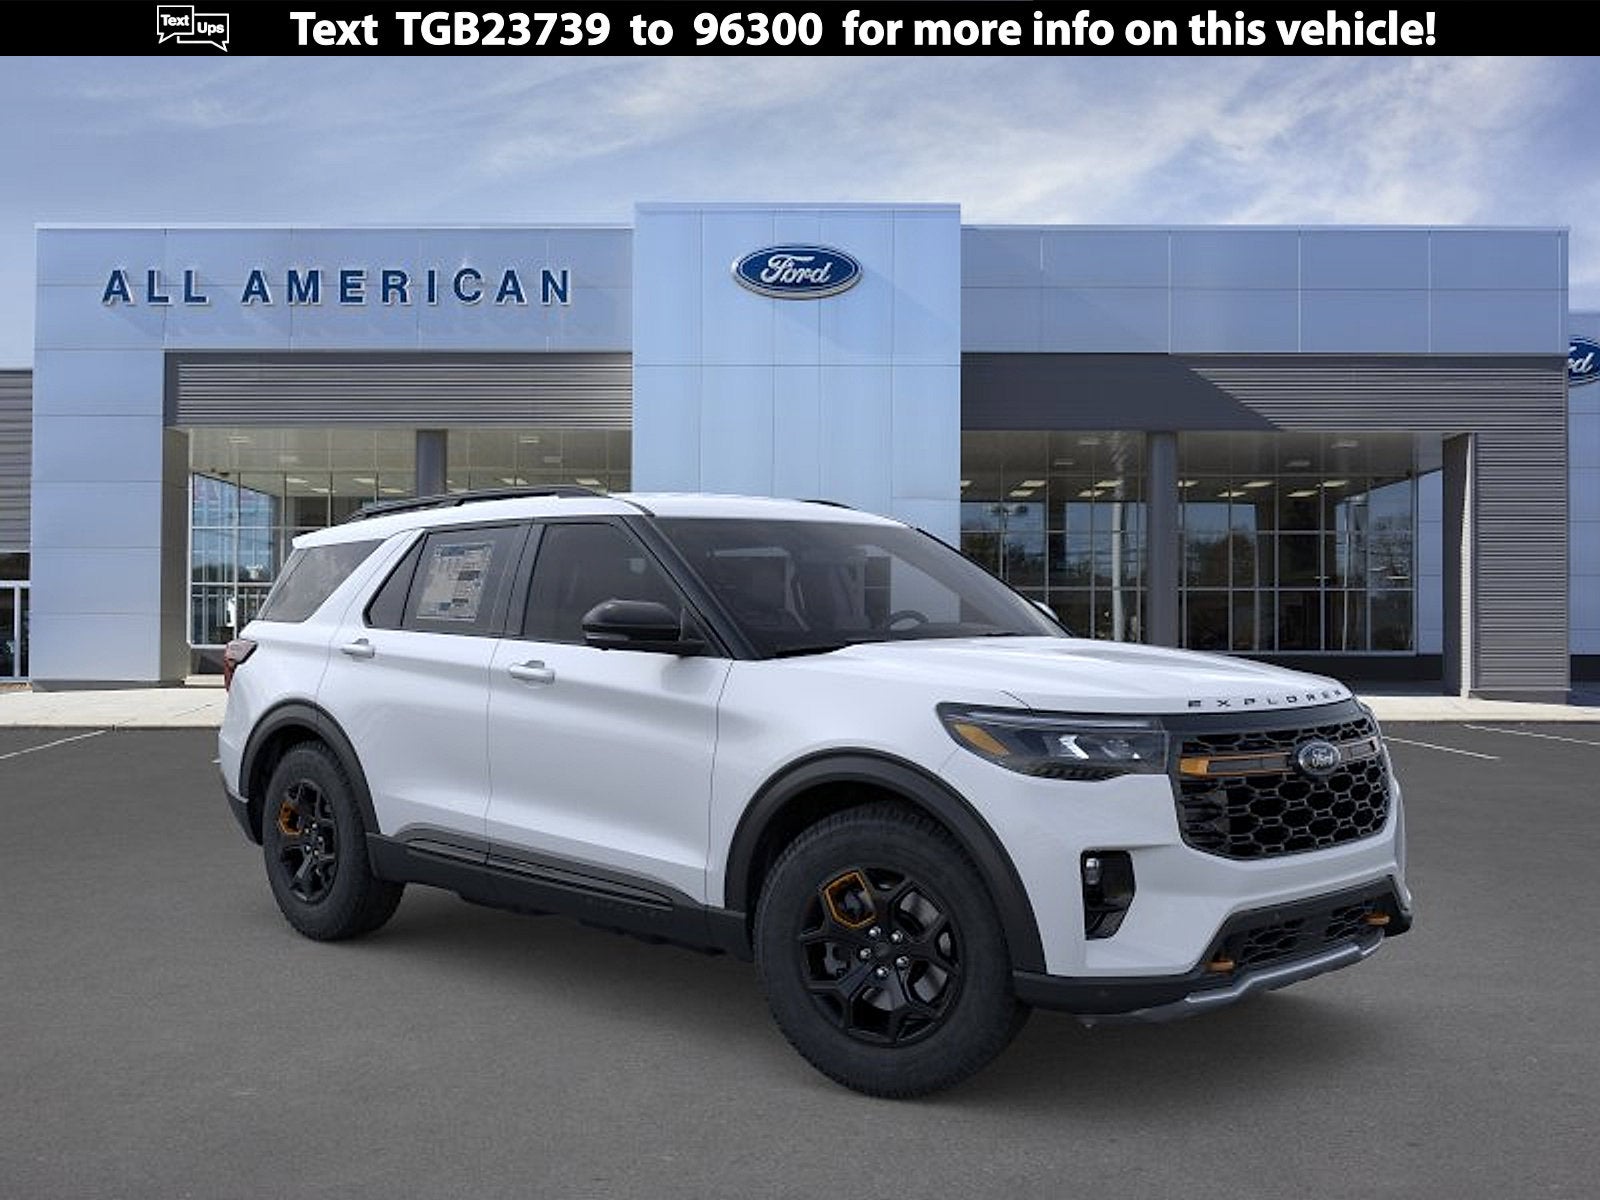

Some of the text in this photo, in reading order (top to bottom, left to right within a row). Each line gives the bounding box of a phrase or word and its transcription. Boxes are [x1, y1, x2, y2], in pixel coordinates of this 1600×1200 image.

[760, 254, 833, 283] Ford
[102, 267, 571, 304] ALL AMERICAN
[1188, 689, 1342, 708] EXPLORER
[1311, 748, 1334, 767] Ford
